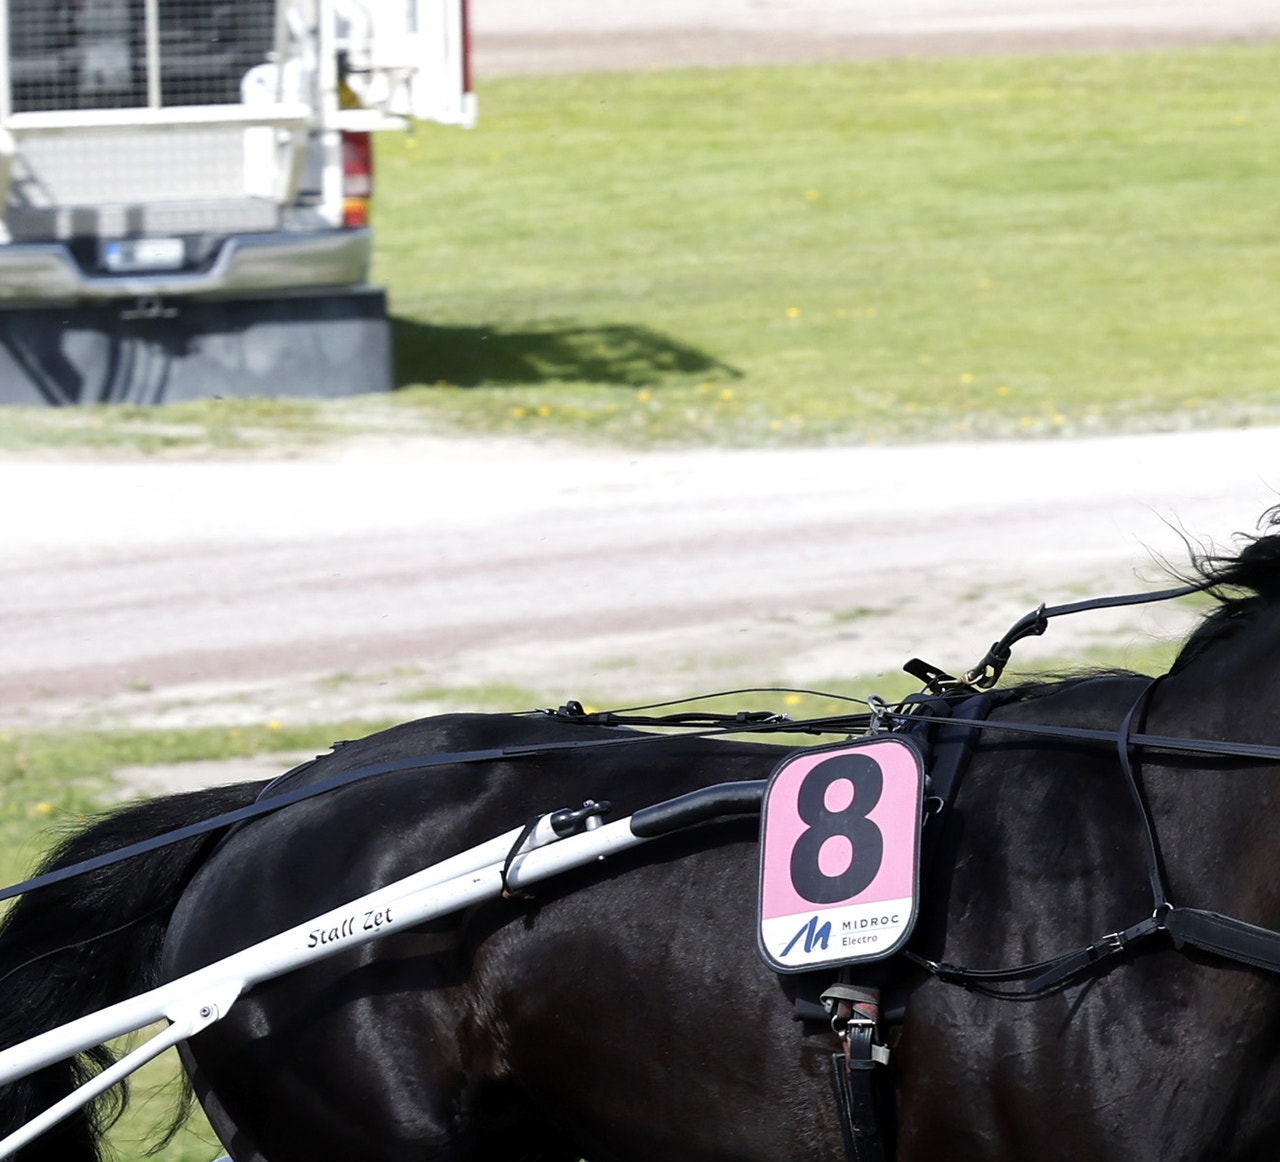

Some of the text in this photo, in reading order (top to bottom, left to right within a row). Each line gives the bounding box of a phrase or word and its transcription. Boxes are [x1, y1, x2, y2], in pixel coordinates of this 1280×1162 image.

[790, 753, 884, 904] 8
[307, 907, 393, 948] Stall Zet
[842, 914, 899, 931] MIDROC
[842, 935, 878, 947] Electro
